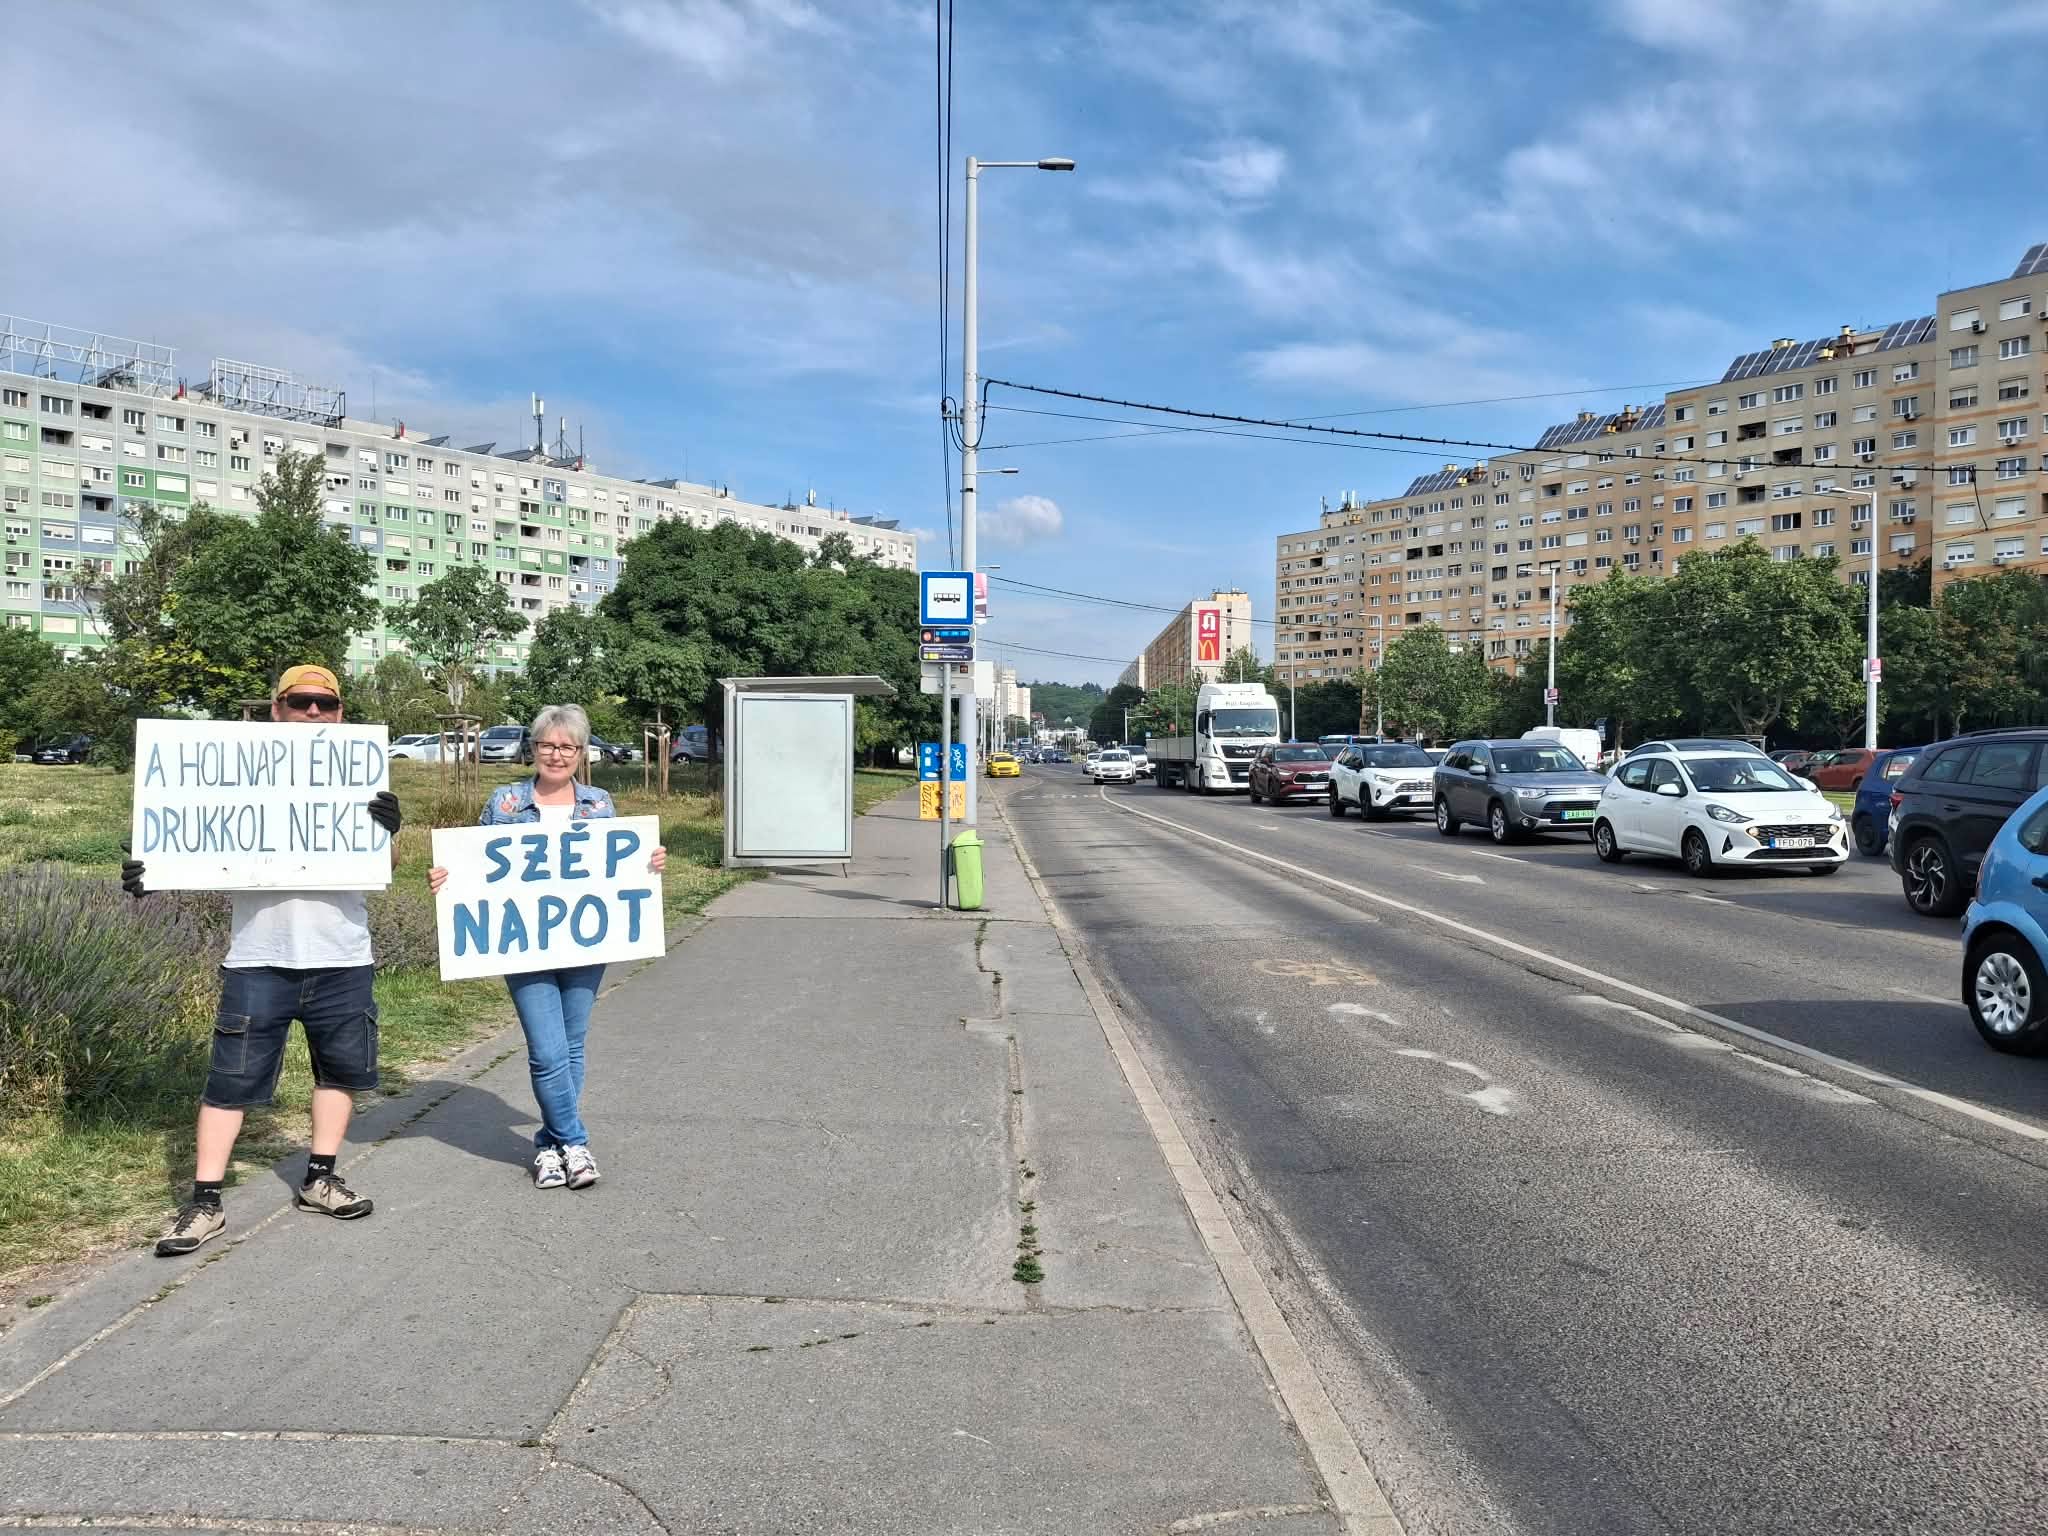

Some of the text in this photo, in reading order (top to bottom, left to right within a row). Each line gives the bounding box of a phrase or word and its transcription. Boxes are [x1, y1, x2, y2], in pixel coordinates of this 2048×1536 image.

[144, 728, 385, 787] A HOLNAPI ÉNED
[143, 803, 276, 853] DRUKKOL
[485, 822, 640, 883] SZÉP
[1776, 838, 1813, 848] TFD-076
[453, 888, 653, 957] NAPOT
